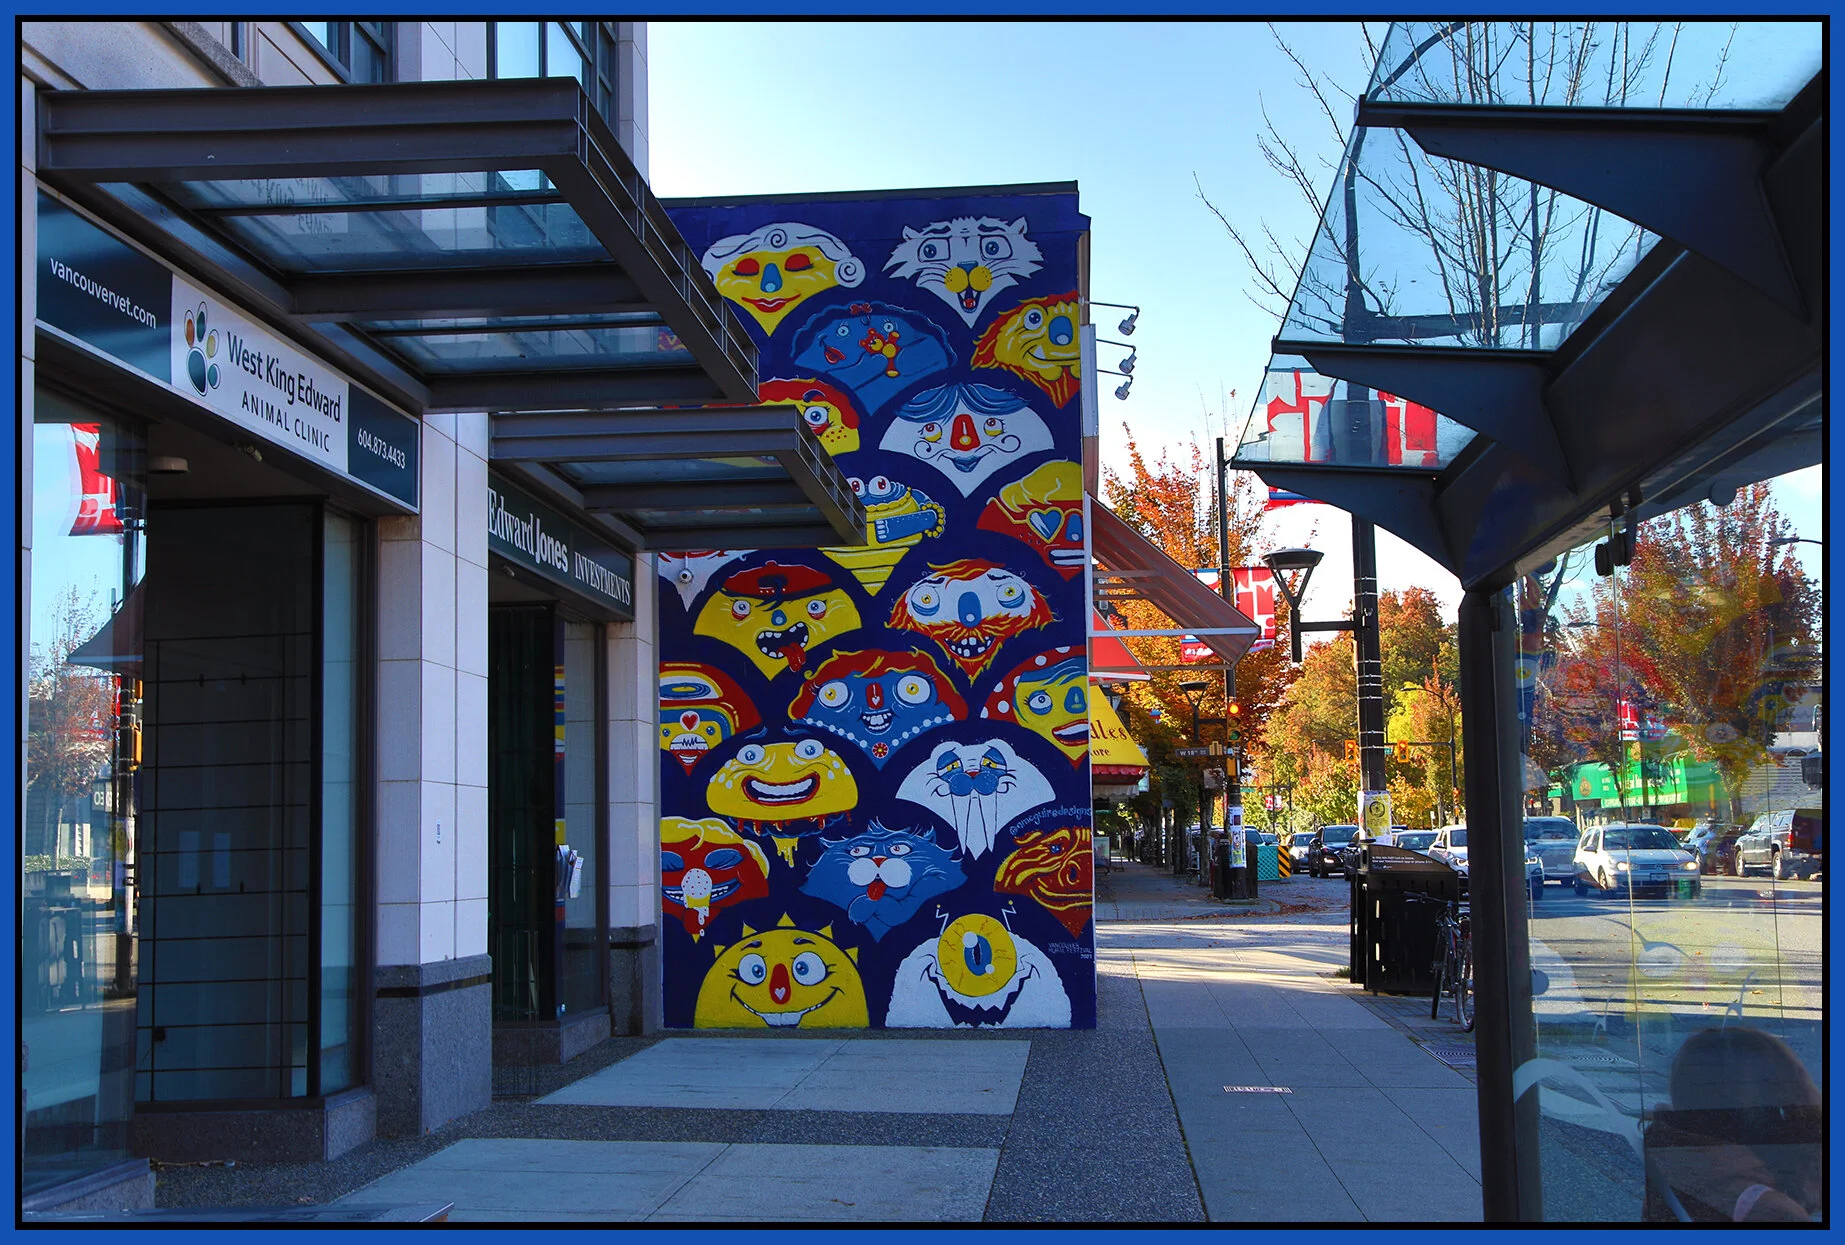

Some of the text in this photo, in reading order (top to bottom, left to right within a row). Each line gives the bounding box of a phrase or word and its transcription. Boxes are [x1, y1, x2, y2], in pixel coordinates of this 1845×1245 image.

[50, 258, 157, 329] vancouvervet.com
[227, 331, 341, 423] West King Edward
[242, 391, 331, 452] ANIMAL CLINIC
[357, 427, 406, 469] 604.873.4433
[488, 487, 631, 606] Edward Jones INVESTMENTS
[1091, 747, 1110, 757] ore
